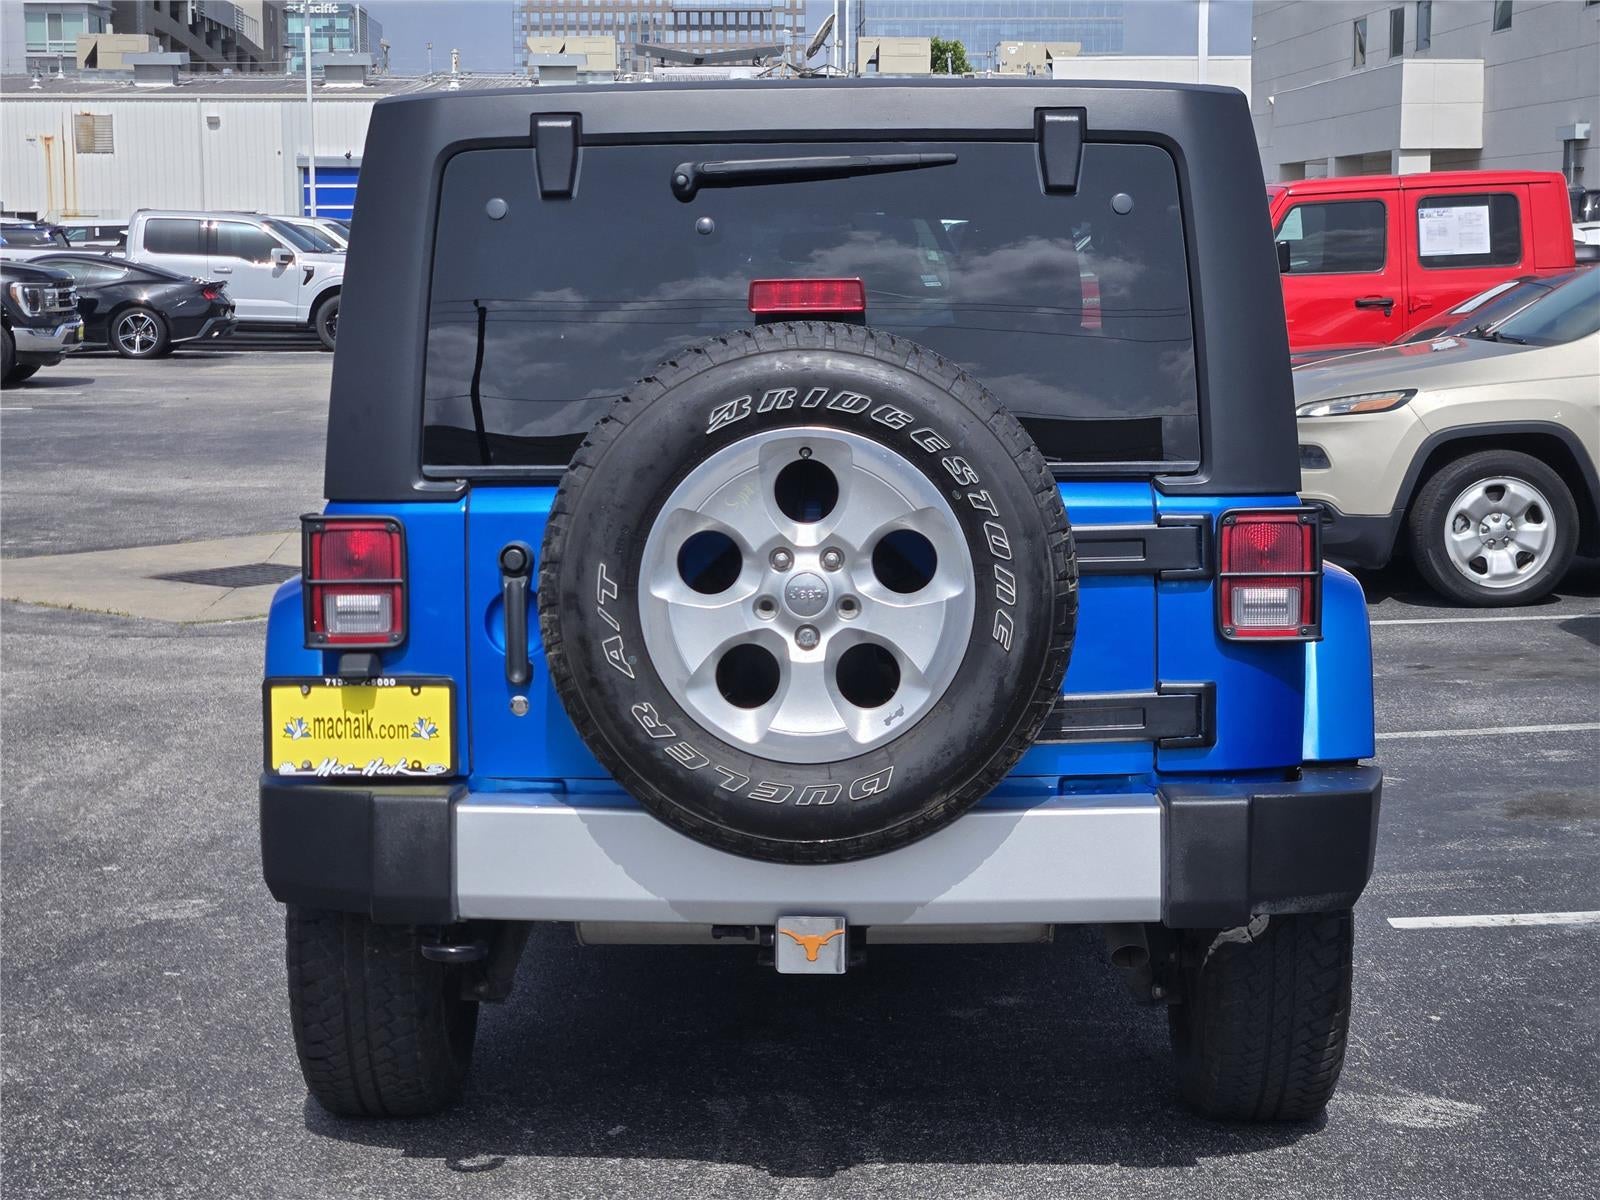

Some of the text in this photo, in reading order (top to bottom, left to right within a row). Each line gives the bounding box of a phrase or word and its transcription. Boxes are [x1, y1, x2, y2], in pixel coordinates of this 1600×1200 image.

[705, 385, 1017, 653] BRIDGESTONE
[313, 710, 410, 740] machaik.com
[597, 563, 895, 806] DUELER A/T
[315, 758, 356, 777] Mac
[361, 757, 410, 777] Haik
